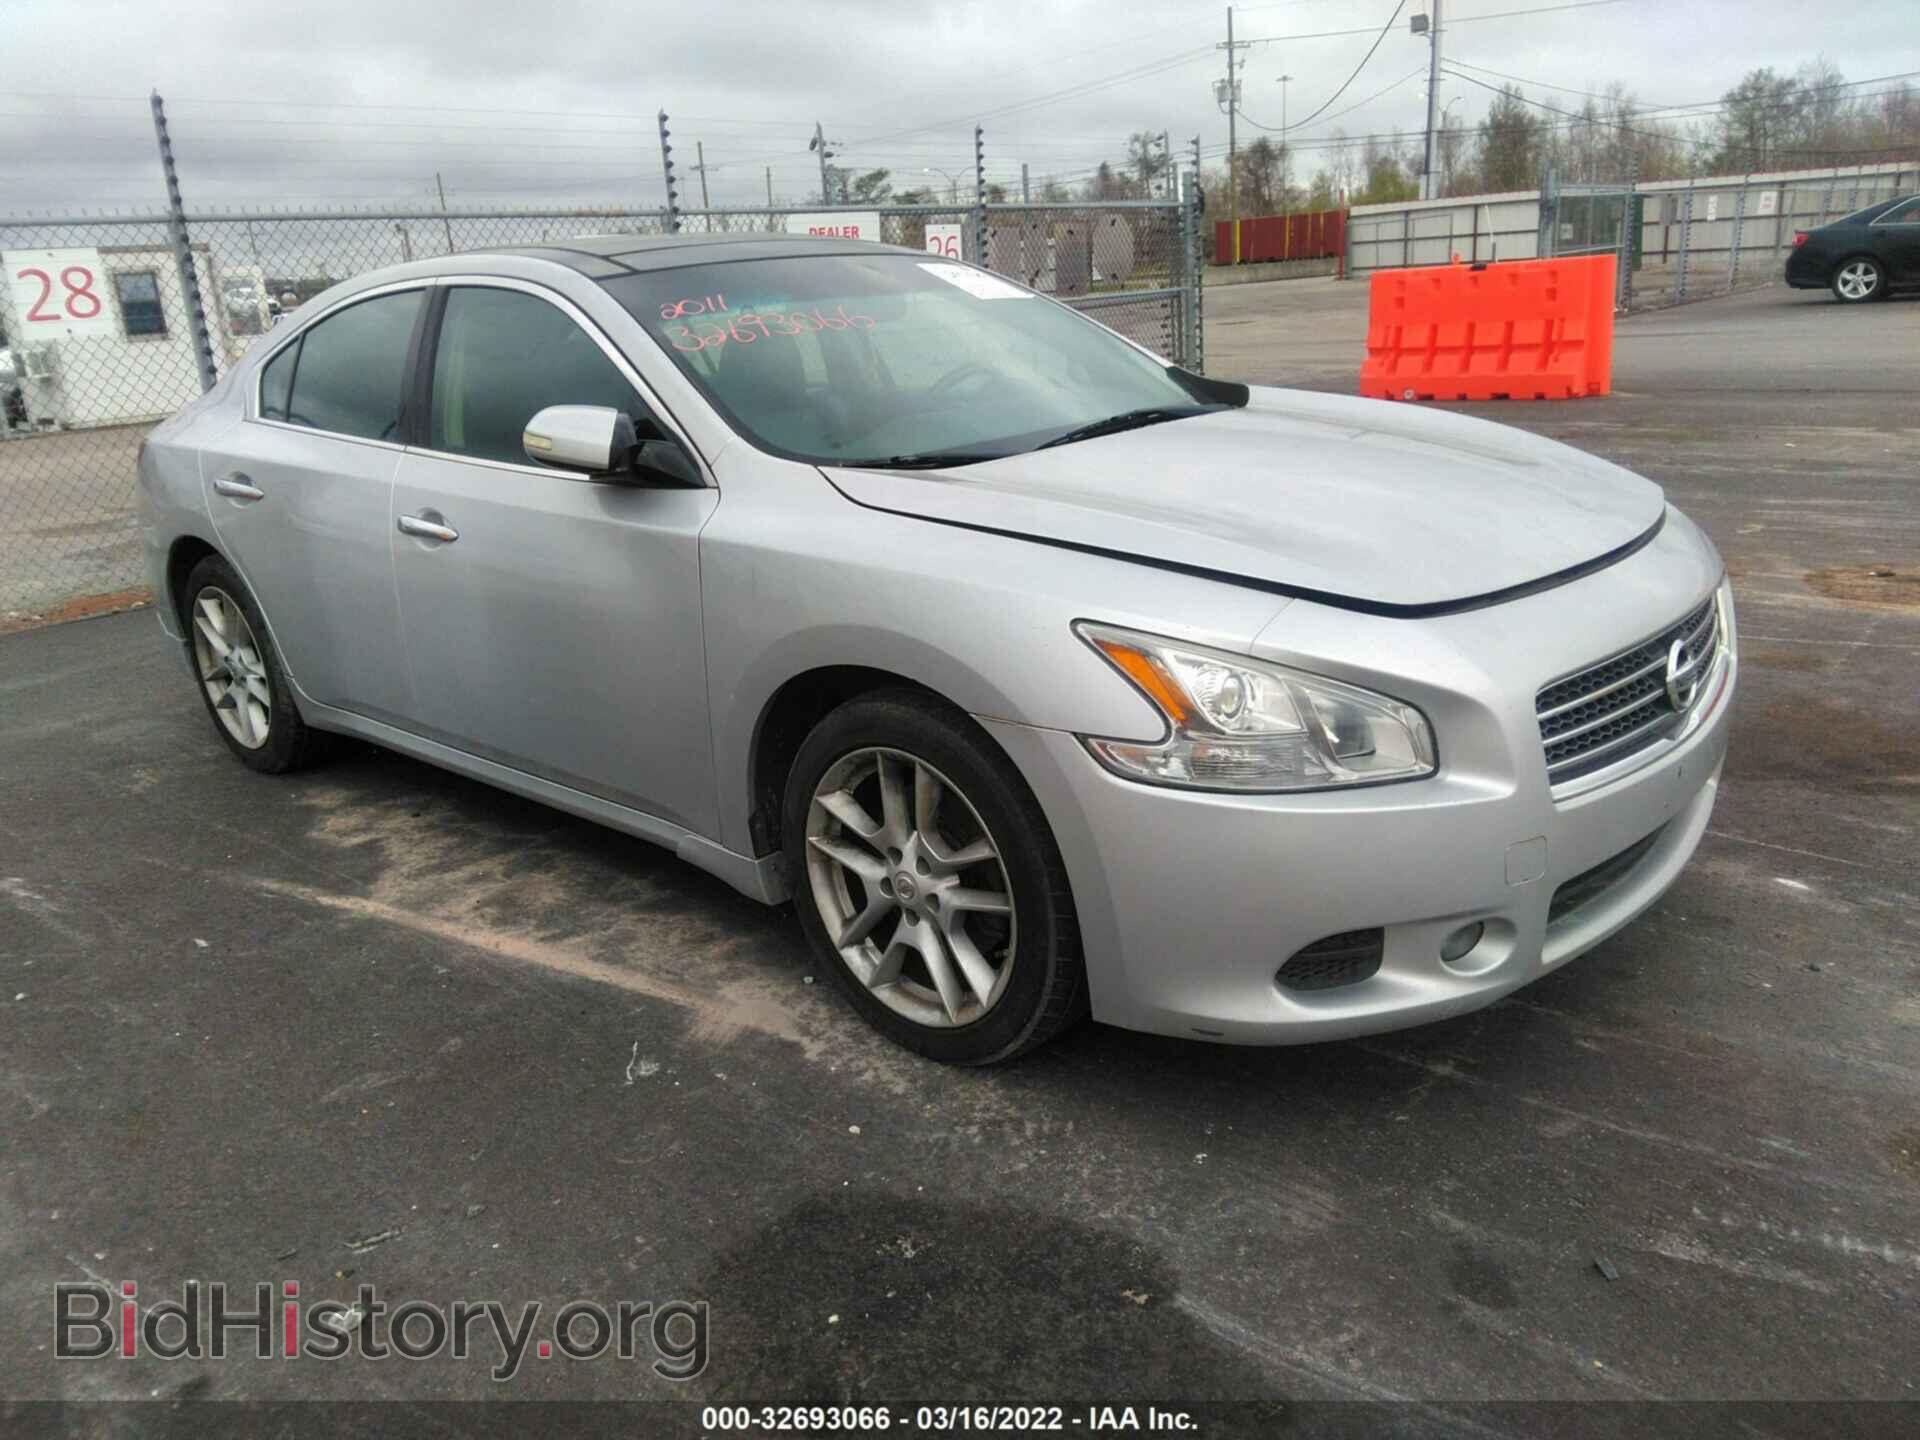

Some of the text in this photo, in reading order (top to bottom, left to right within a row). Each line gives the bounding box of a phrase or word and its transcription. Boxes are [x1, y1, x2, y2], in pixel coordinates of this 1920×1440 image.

[809, 225, 860, 239] DEALER
[17, 265, 102, 322] 28
[660, 294, 728, 320] 2011
[664, 304, 876, 351] 32693066
